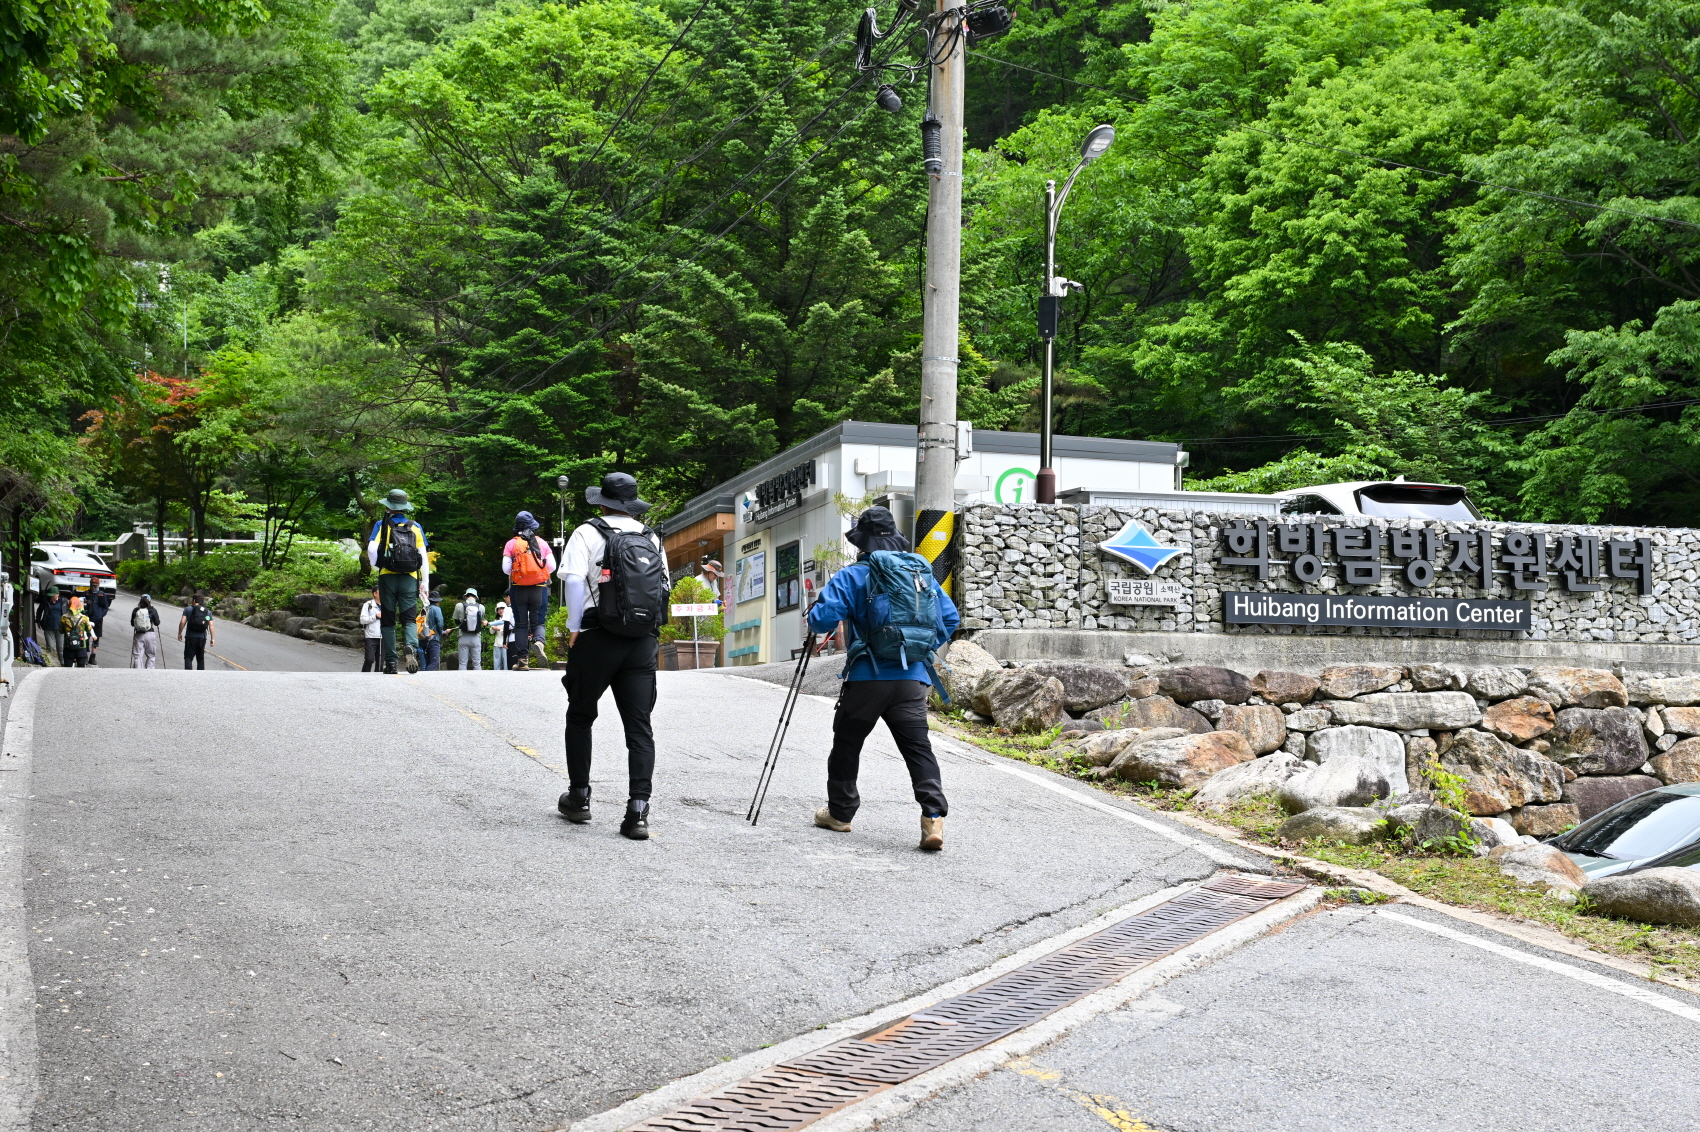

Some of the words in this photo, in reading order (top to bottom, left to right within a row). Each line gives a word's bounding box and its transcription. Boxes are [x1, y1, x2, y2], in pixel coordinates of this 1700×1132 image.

[786, 497, 796, 508] Center
[1218, 519, 1652, 595] 희방탐방지원센터
[1110, 581, 1154, 596] 국립공원
[1160, 585, 1181, 594] 소백산
[1234, 595, 1319, 622] Huibang
[1326, 598, 1448, 621] Information
[1456, 602, 1523, 623] Center
